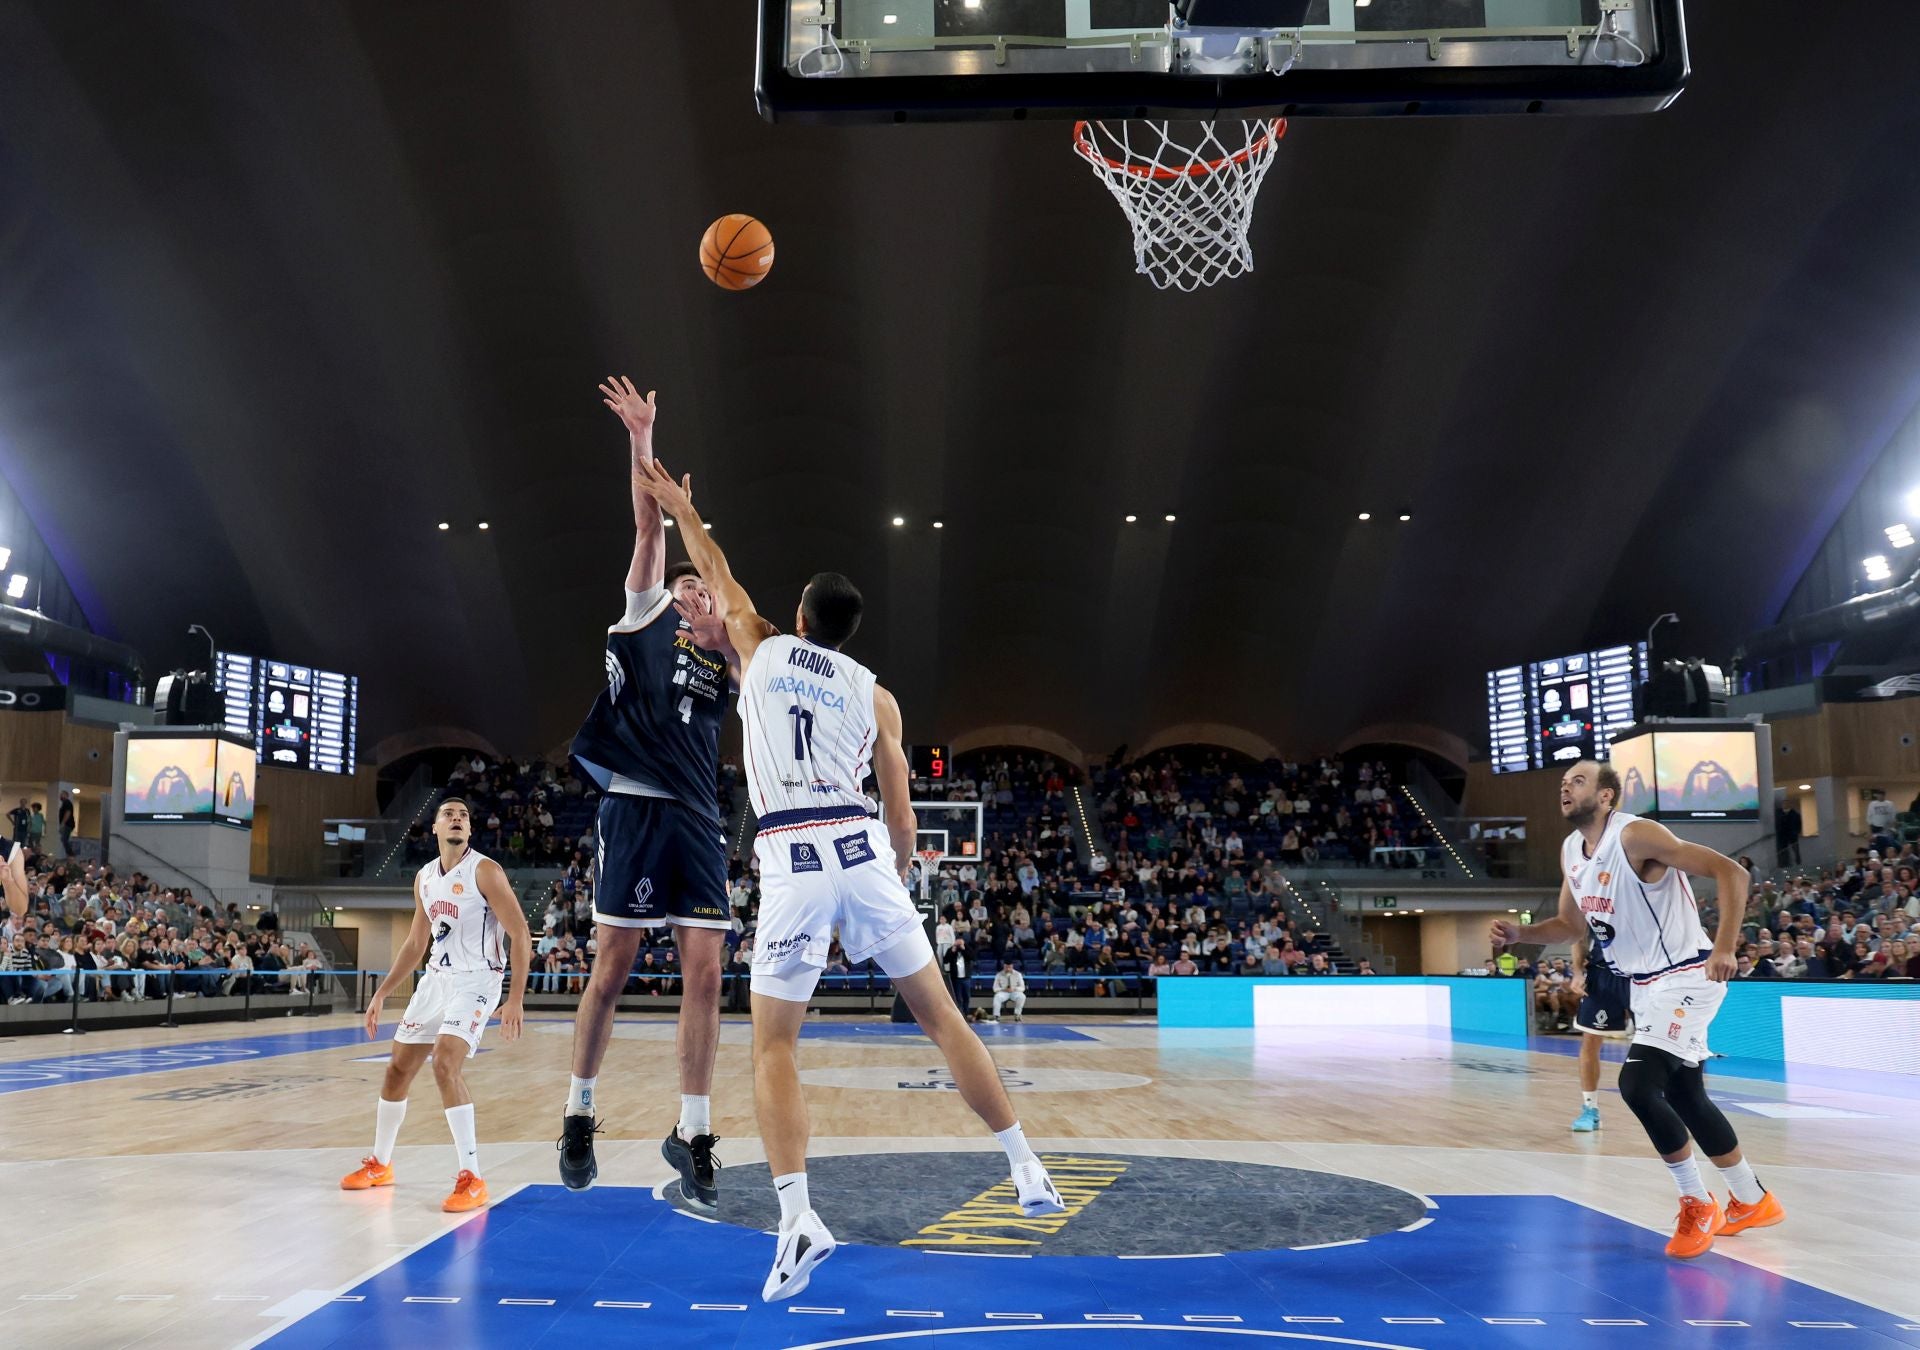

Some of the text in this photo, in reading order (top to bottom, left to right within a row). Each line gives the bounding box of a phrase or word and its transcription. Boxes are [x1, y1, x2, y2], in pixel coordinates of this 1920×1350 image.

[678, 695, 694, 724] 4
[931, 747, 940, 758] 4
[931, 759, 943, 777] 9
